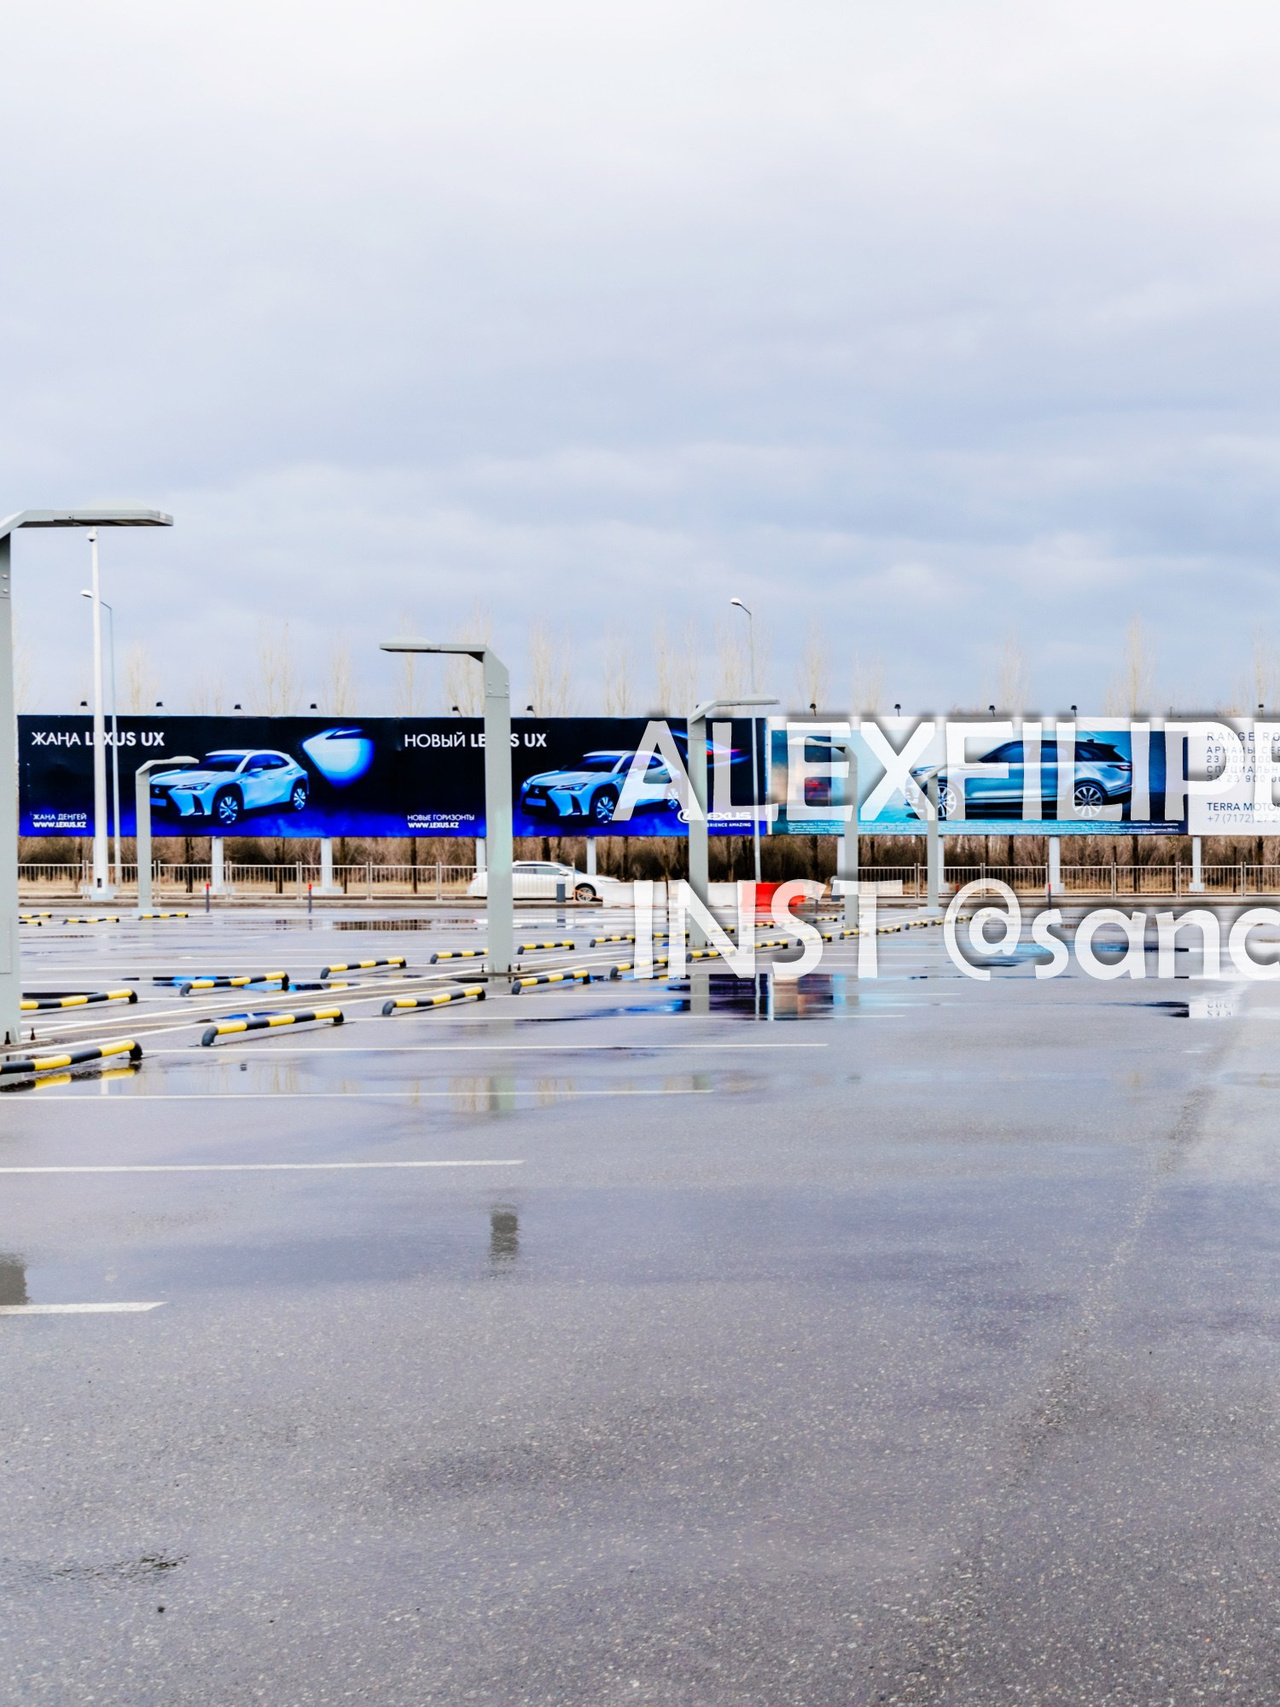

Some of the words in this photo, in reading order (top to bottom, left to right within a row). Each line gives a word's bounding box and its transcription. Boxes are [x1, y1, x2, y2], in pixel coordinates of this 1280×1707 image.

[31, 732, 82, 748] ЖАҢА
[85, 732, 137, 747] LXUS
[141, 732, 165, 746] UX
[404, 731, 466, 748] НОВЫЙ
[470, 733, 520, 748] LES
[524, 733, 547, 748] UX
[1206, 731, 1255, 742] RANGE
[1206, 755, 1220, 764] 23
[1207, 802, 1241, 811] TERRA
[407, 814, 432, 822] НОВЫЕ
[433, 814, 475, 822] ГОРИЗОНТЫ
[1207, 813, 1220, 823] +7
[1222, 813, 1255, 824] (7172)
